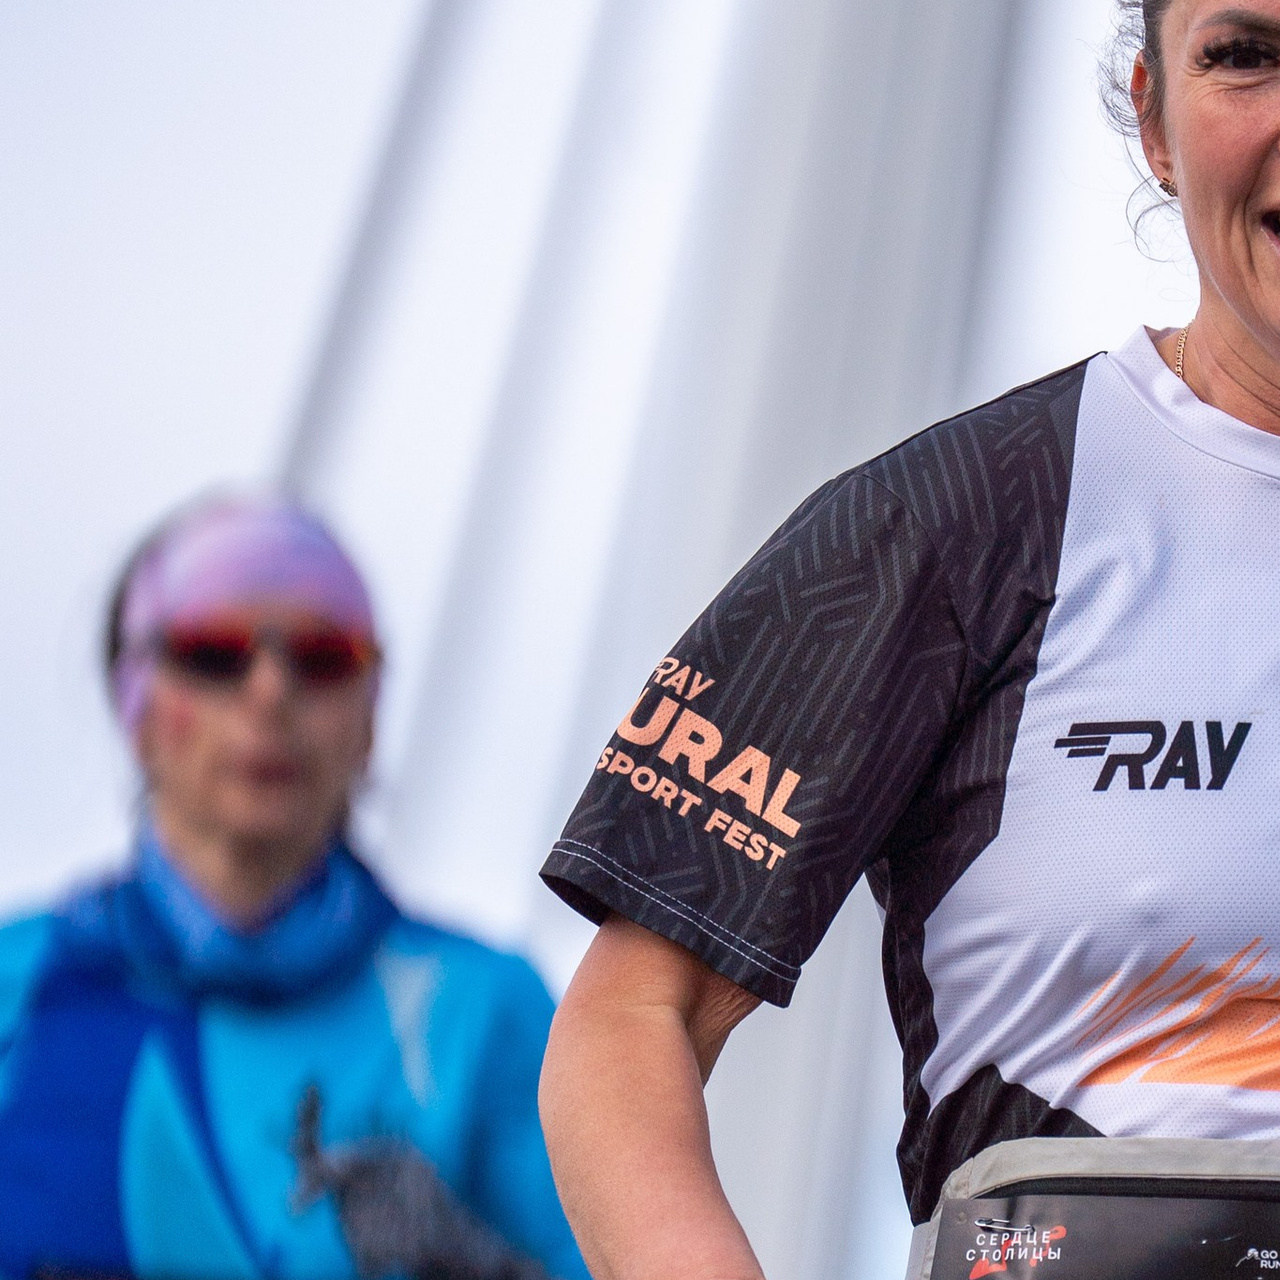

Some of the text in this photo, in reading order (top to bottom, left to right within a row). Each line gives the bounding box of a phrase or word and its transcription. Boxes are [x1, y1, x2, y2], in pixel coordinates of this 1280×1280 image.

[652, 657, 715, 701] RAY
[616, 687, 801, 838] URAL
[1053, 720, 1252, 791] RAY
[596, 746, 786, 870] SPORT FEST
[966, 1247, 1061, 1262] СТОЛИЦЫ
[976, 1231, 1051, 1246] СЕРДЦЕ
[1260, 1250, 1278, 1260] GO
